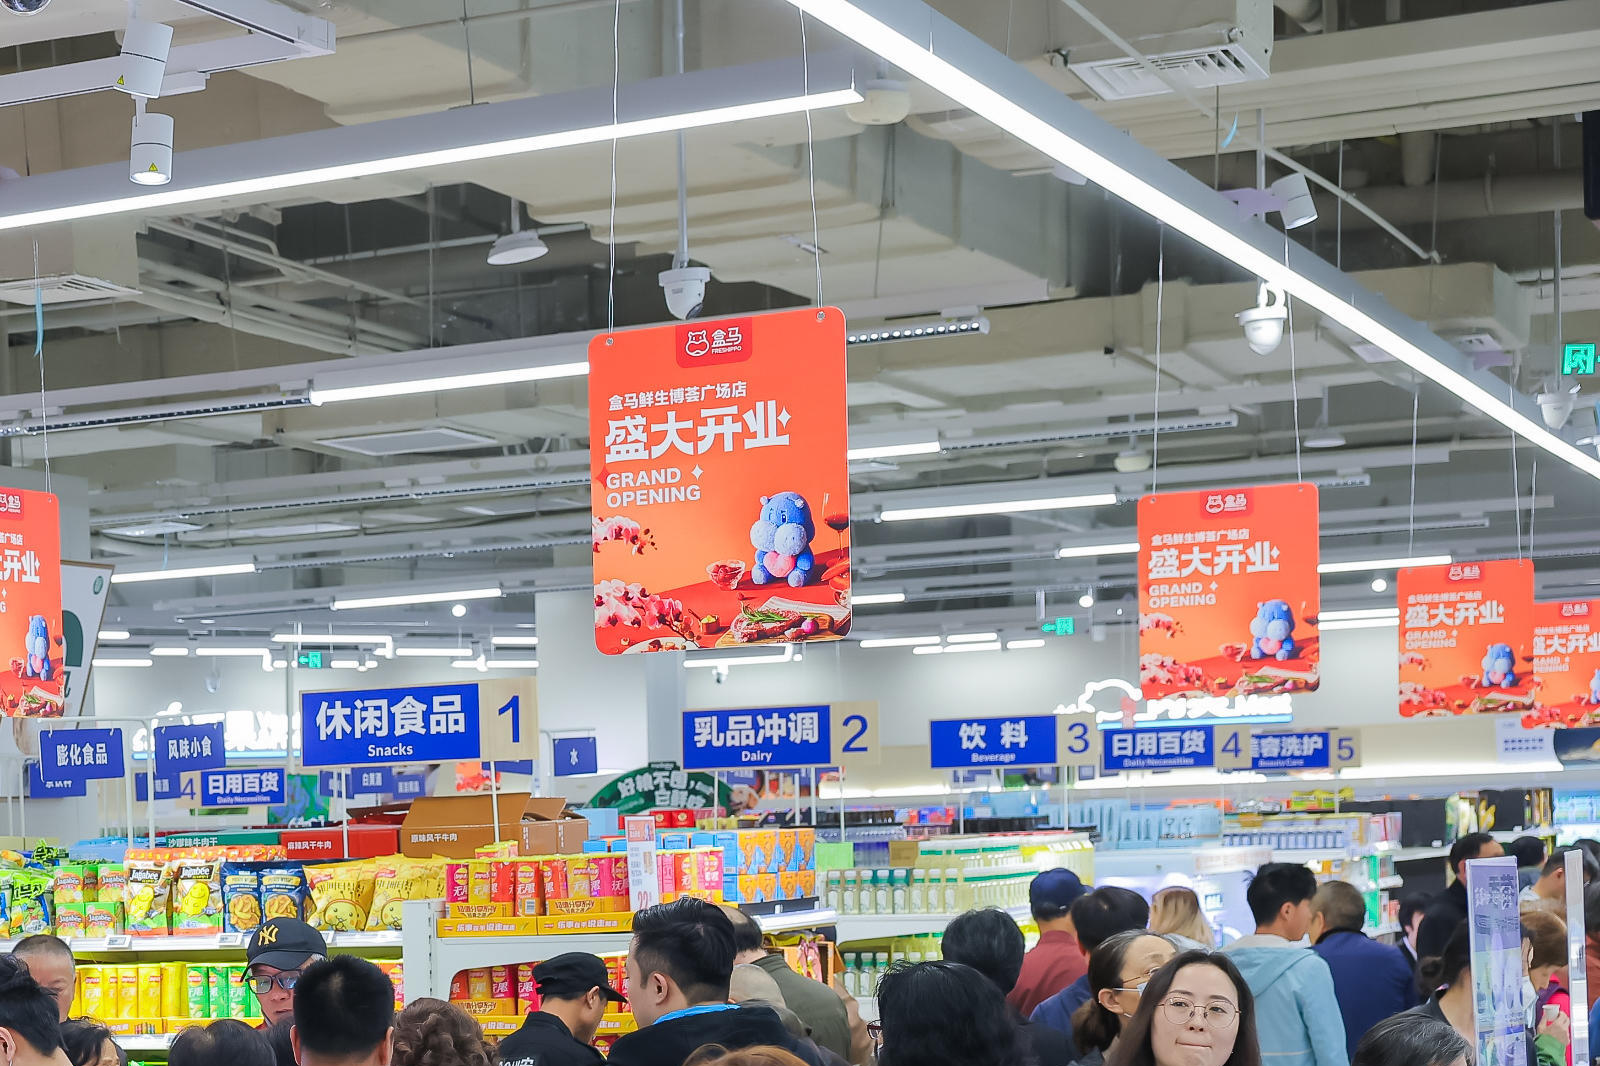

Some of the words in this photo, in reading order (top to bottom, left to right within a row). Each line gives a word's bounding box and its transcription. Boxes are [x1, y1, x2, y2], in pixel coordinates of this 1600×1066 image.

[711, 326, 743, 347] 盒马
[608, 380, 747, 411] 盒马鲜生博荟广场店
[604, 399, 790, 464] 盛大开业
[606, 467, 681, 490] GRAND
[606, 484, 701, 509] OPENING
[1148, 541, 1280, 580] 盛大开业
[1148, 582, 1203, 596] GRAND
[1148, 594, 1216, 608] OPENING
[1405, 600, 1504, 628] 盛大开业
[316, 694, 466, 742] 休闲食品
[497, 695, 520, 743] 1
[693, 712, 819, 748] 乳品冲调
[841, 714, 869, 753] 2
[958, 720, 1028, 749] 饮料
[1067, 723, 1089, 753] 3
[56, 743, 108, 767] 膨化食品
[168, 736, 212, 760] 风味小食
[367, 742, 414, 758] Snacks
[741, 750, 772, 762] Dairy
[1112, 730, 1206, 757] 日用百货
[1221, 732, 1241, 758] 4
[1337, 737, 1354, 761] 5
[180, 777, 196, 800] 4
[208, 772, 279, 795] 日用百货
[411, 833, 458, 843] 原味风干牛肉
[57, 877, 79, 885] Jagabee
[131, 870, 159, 881] Jagabee
[181, 866, 210, 877] Jagabee
[258, 924, 279, 947] NY
